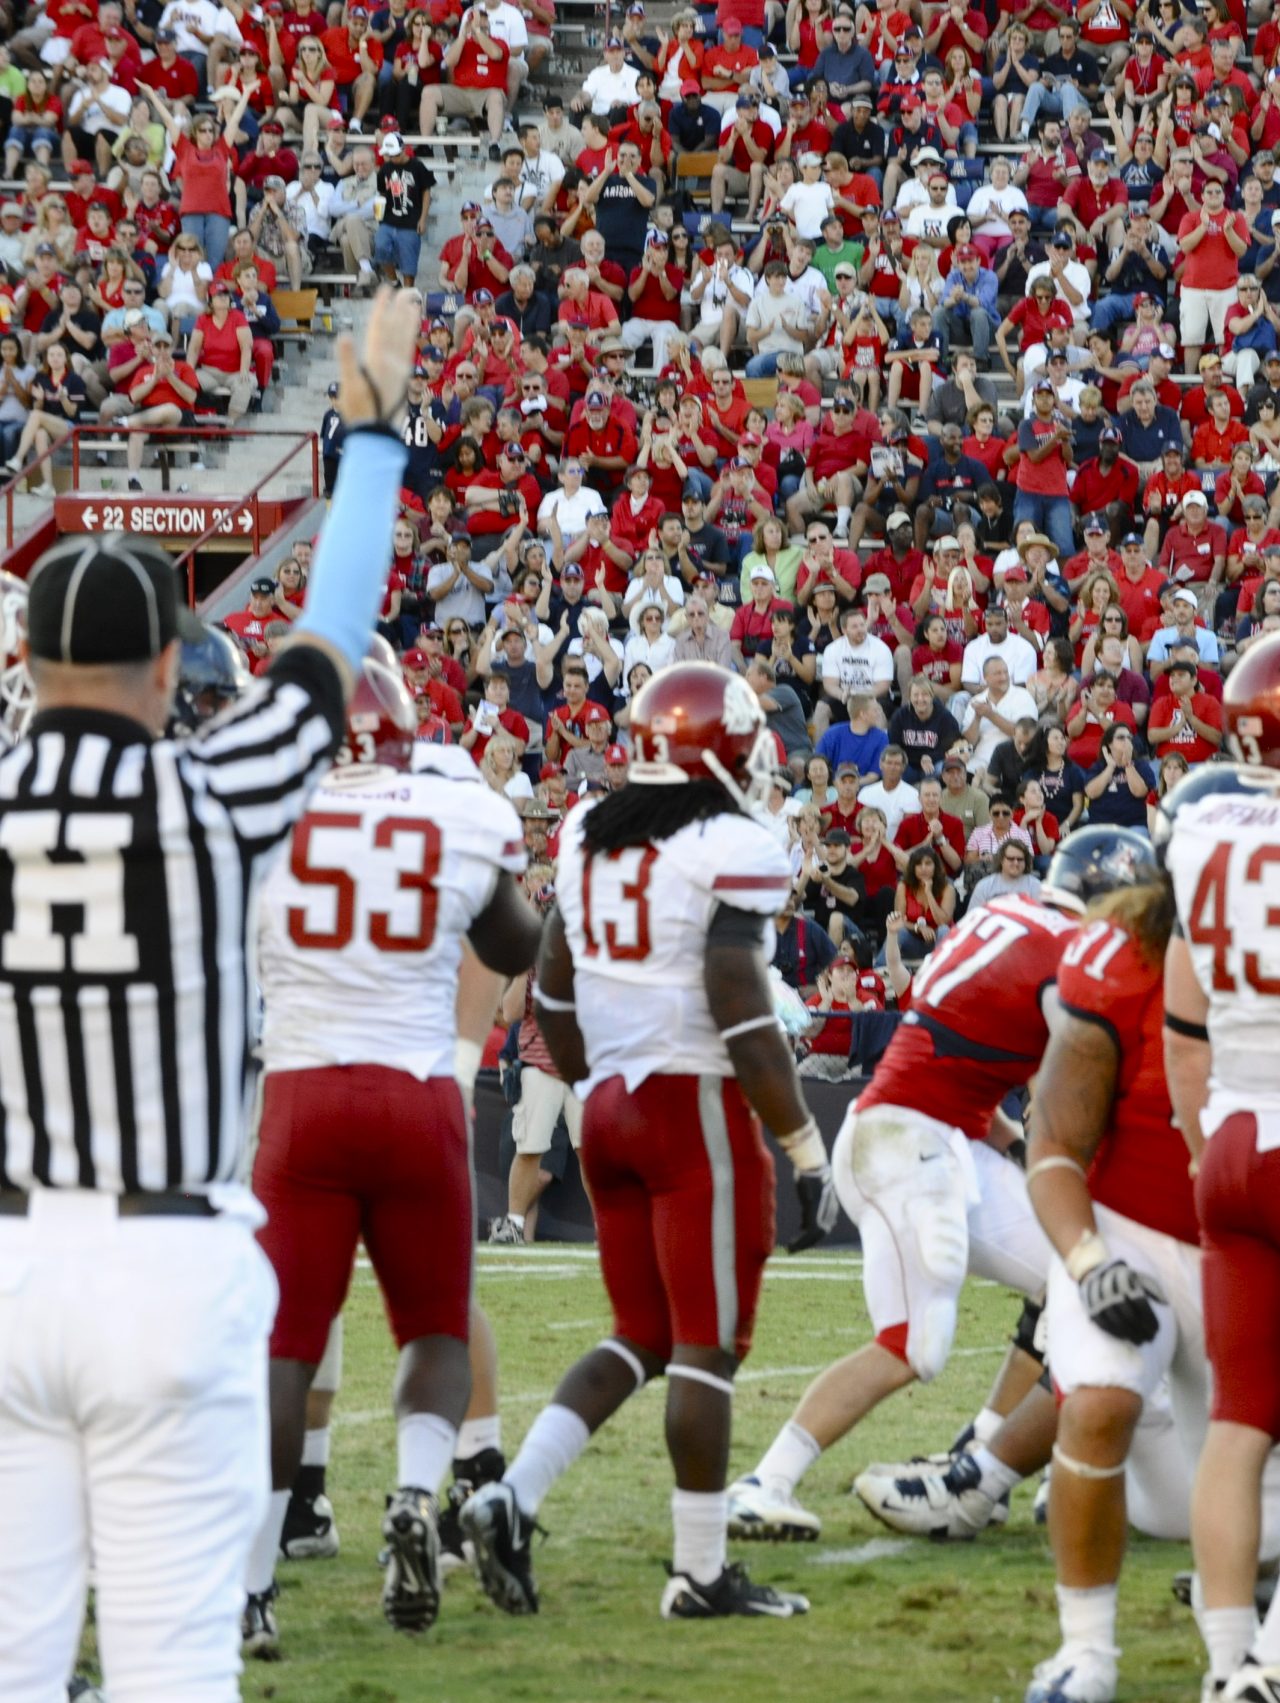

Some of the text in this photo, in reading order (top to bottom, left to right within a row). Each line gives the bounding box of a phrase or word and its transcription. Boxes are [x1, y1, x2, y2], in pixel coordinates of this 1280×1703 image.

[603, 184, 637, 199] ARIZON
[103, 506, 124, 531] 22
[130, 506, 206, 533] SECTION
[635, 733, 670, 764] 13
[0, 808, 140, 974] H
[287, 812, 443, 954] 53
[581, 842, 661, 962] 13
[911, 906, 1031, 1008] 37
[1061, 920, 1130, 981] 31
